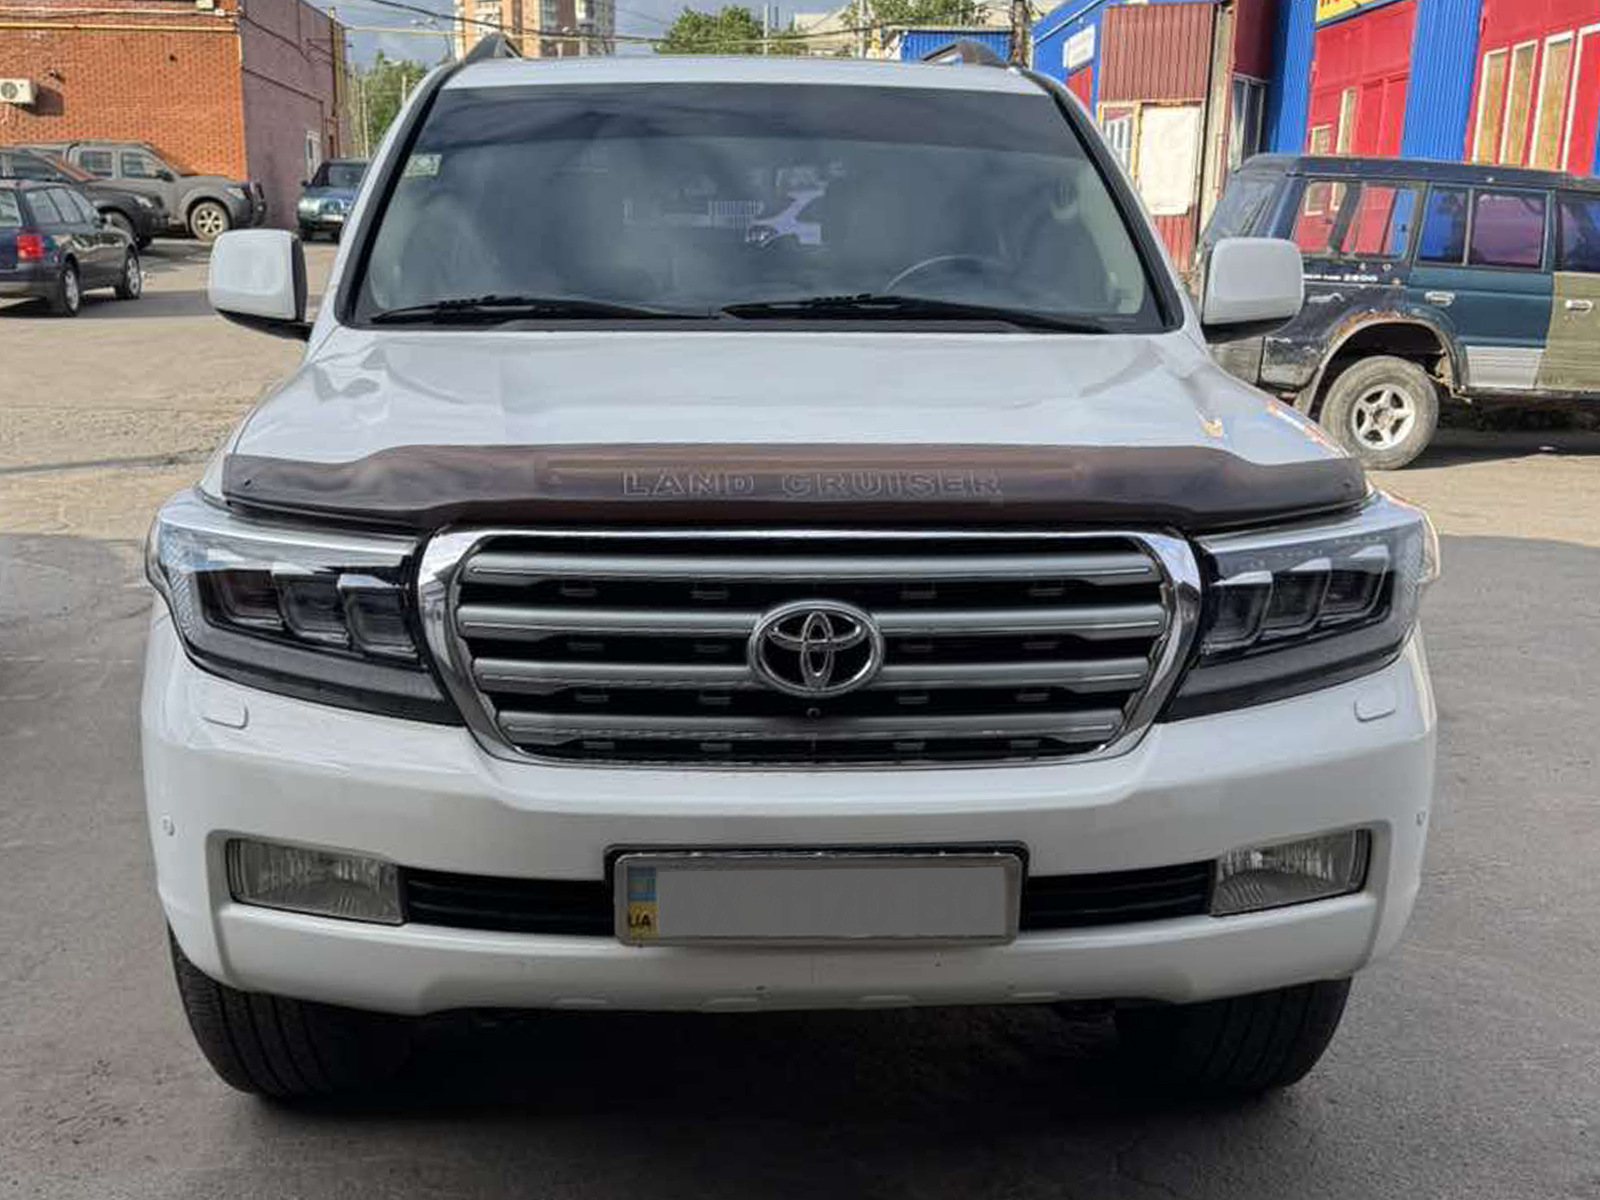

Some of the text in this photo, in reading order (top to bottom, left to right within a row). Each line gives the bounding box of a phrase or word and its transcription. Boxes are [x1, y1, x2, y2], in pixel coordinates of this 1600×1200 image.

[622, 470, 1004, 498] LAND CRUISER
[628, 913, 653, 929] UA
